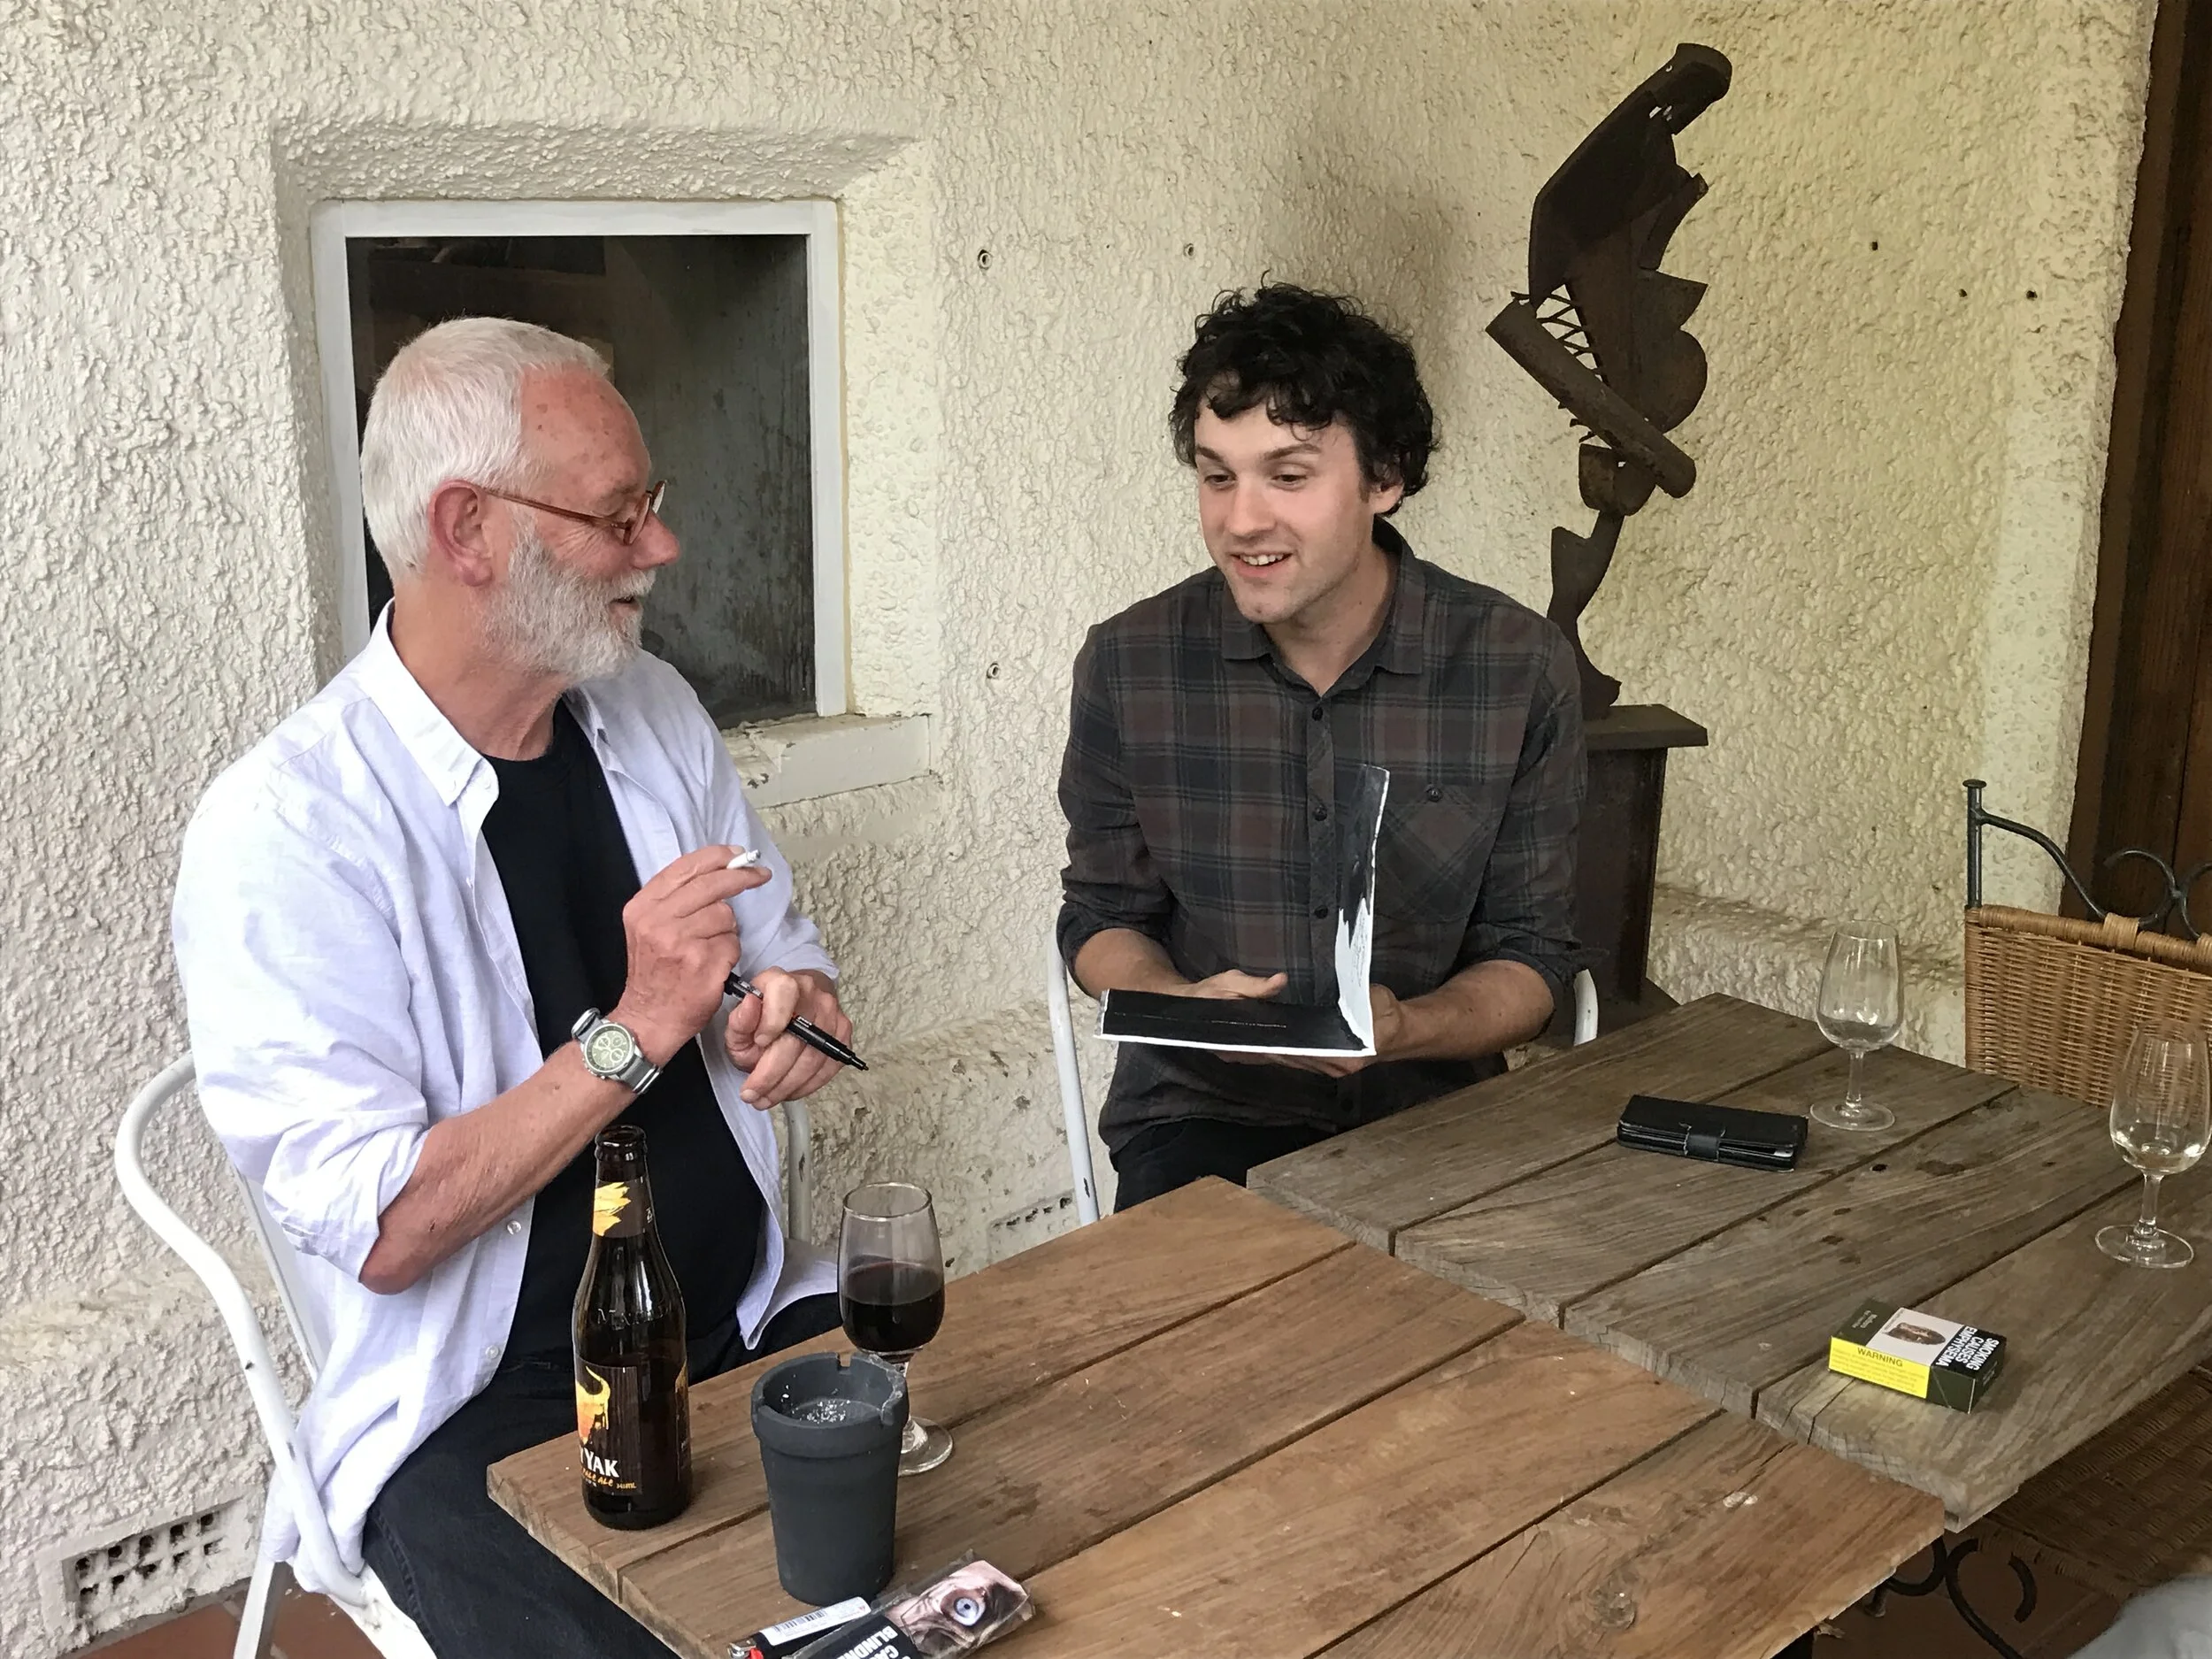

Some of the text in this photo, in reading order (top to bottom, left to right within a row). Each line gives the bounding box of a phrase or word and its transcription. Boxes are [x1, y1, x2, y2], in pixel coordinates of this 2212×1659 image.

[1857, 1347, 1903, 1367] WARNING
[1935, 1325, 1978, 1367] EMPHYSEMA
[1955, 1336, 1985, 1363] CAUSES
[1966, 1338, 2000, 1371] SMOKING
[584, 1447, 619, 1478] YAK
[835, 1624, 899, 1659] BLINDN
[869, 1644, 900, 1659] CA
